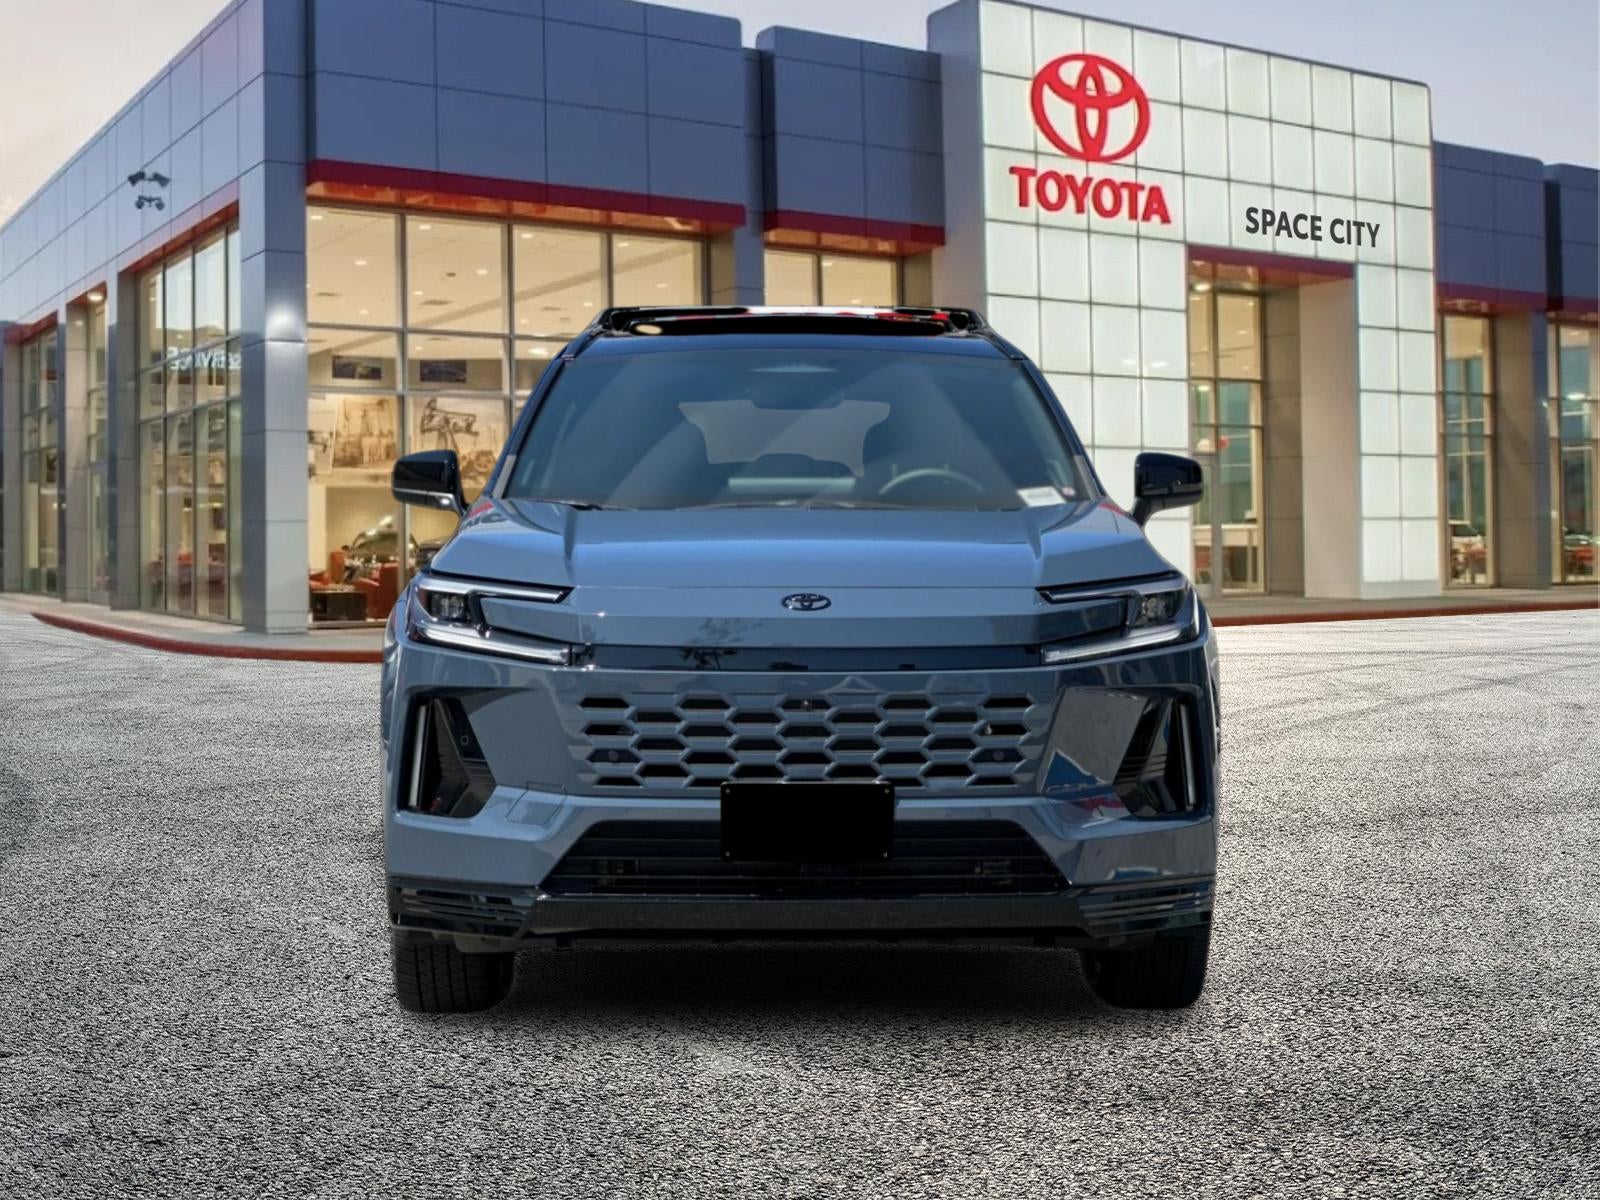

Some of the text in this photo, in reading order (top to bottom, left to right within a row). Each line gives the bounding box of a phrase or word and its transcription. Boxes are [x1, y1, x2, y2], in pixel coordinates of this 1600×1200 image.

[1009, 166, 1171, 224] TOYOTA
[1245, 206, 1380, 248] SPACE CITY
